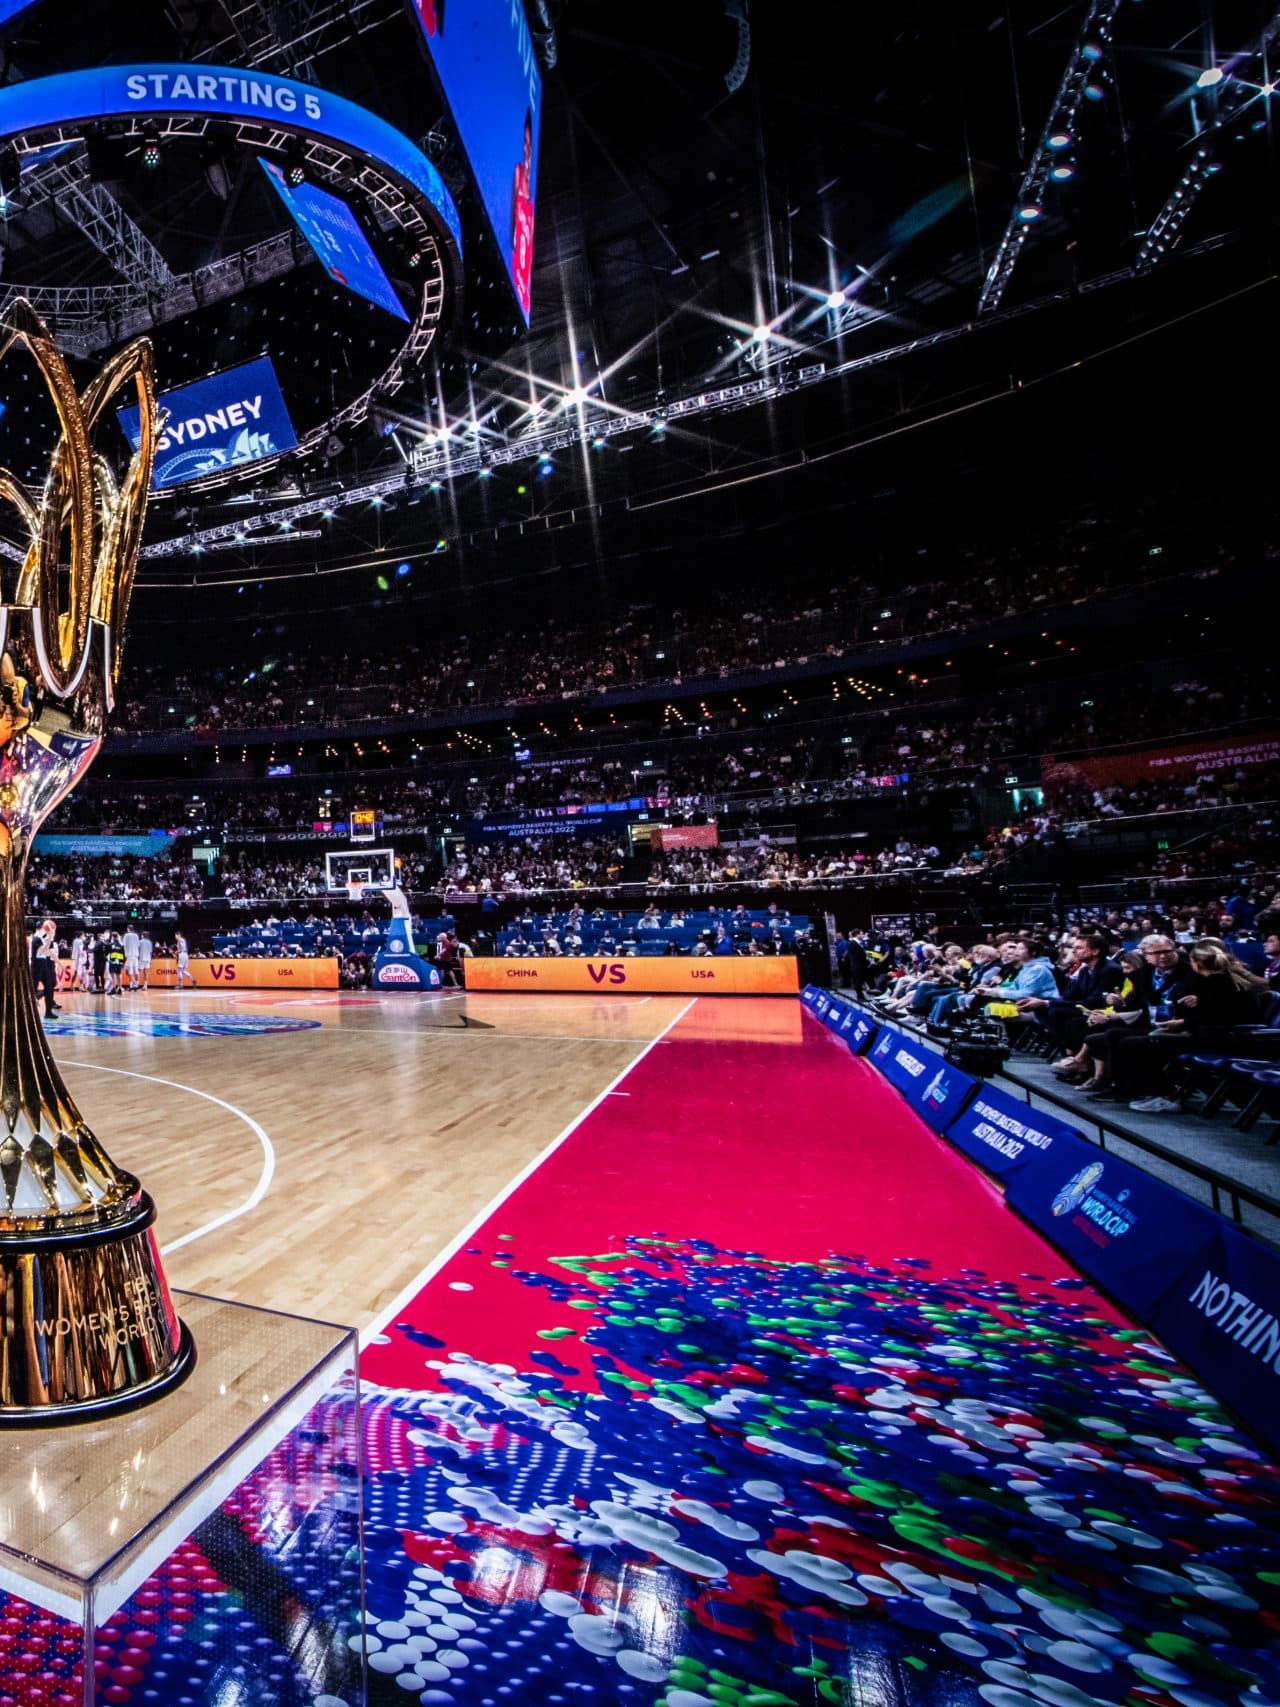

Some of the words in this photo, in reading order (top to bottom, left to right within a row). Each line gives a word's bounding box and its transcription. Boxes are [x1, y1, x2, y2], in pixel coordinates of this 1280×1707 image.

[126, 74, 297, 113] STARTING
[304, 94, 321, 120] 5
[157, 395, 263, 451] SYDNEY
[156, 968, 177, 976] CHINA
[210, 963, 236, 981] VS
[277, 969, 294, 977] USA
[506, 968, 538, 978] CHINA
[587, 963, 626, 985] VS
[691, 969, 715, 979] USA
[1081, 1196, 1113, 1226] WORLD
[1104, 1215, 1130, 1237] CUP
[35, 1305, 130, 1337] WOMEN'S
[99, 1320, 156, 1350] WORLD
